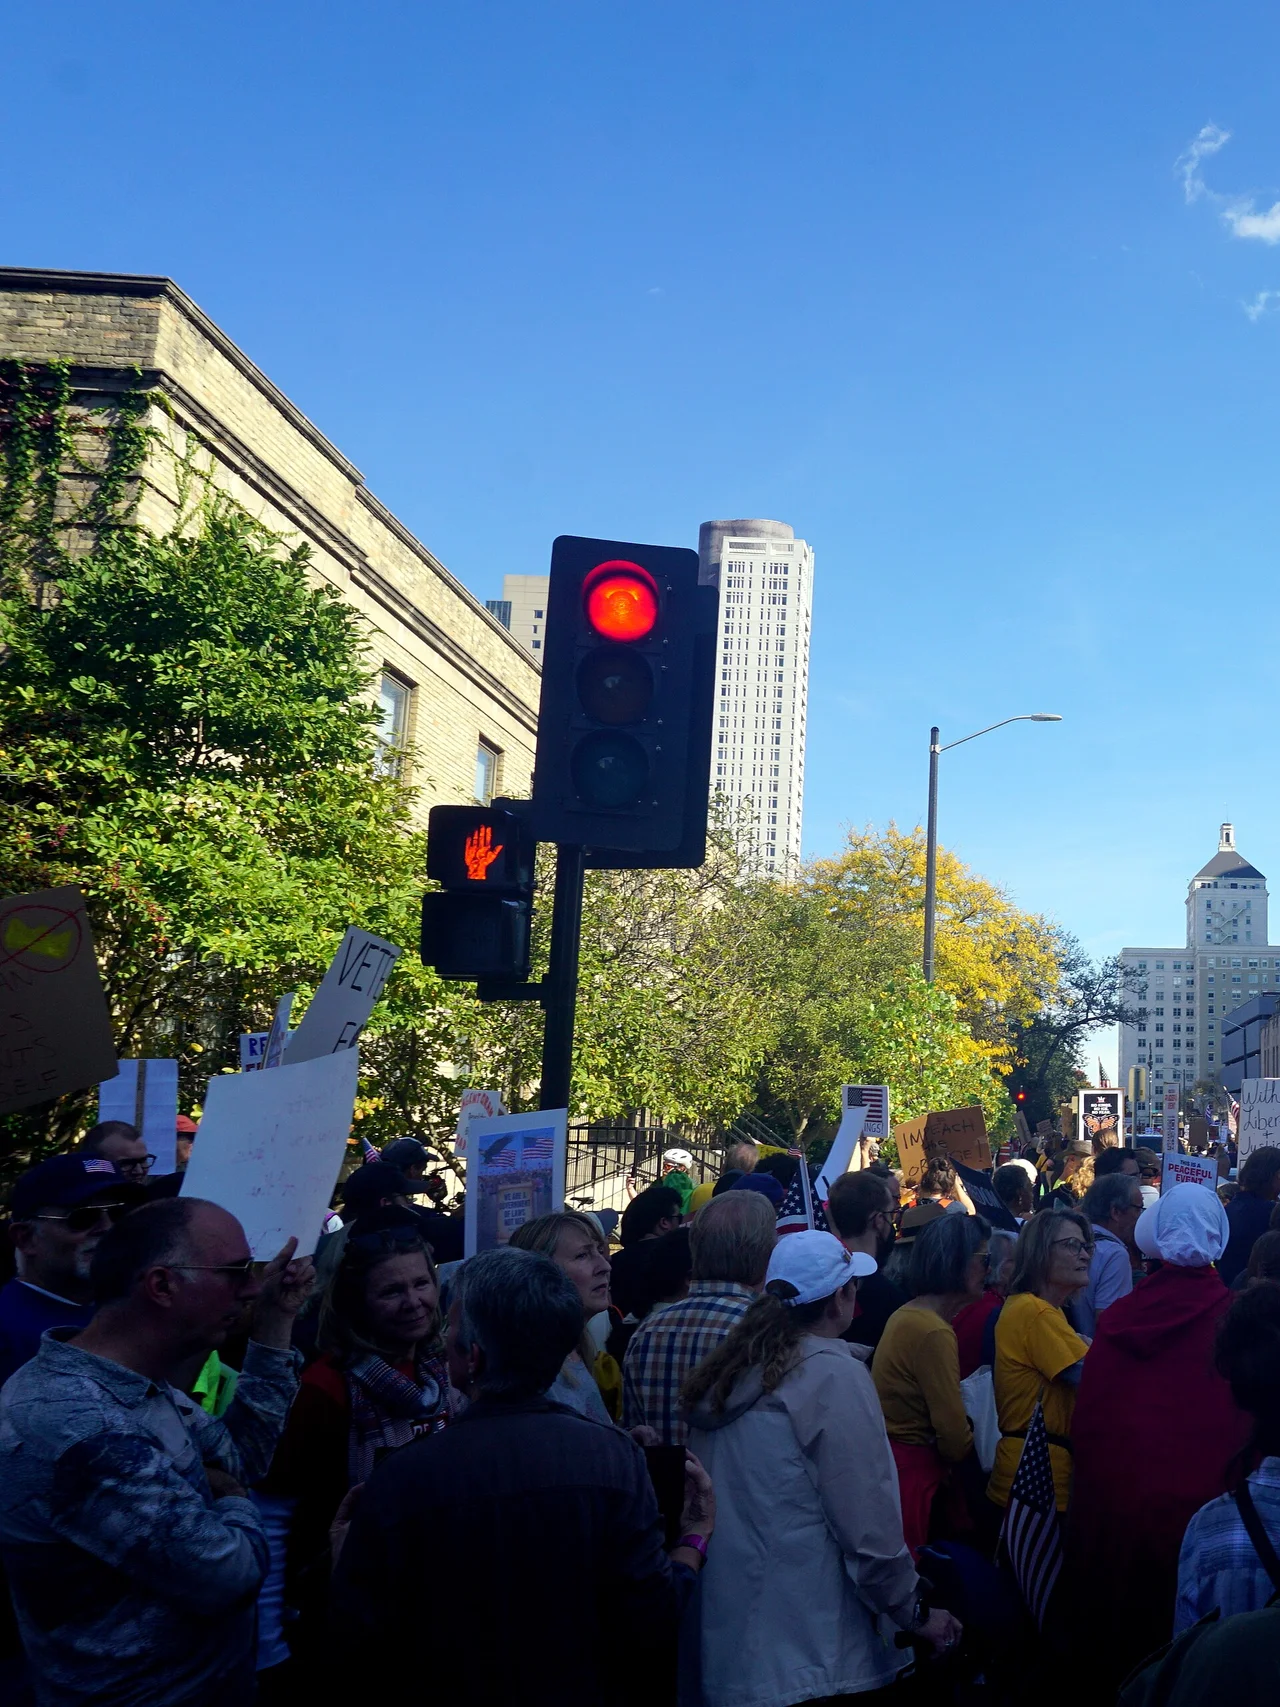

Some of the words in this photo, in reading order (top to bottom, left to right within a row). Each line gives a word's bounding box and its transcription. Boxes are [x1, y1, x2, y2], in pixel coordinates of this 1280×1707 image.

[864, 1122, 884, 1134] INGS!
[903, 1118, 974, 1149] IMPEACH
[1168, 1163, 1212, 1179] PEACEFUL
[1175, 1174, 1203, 1184] EVENT
